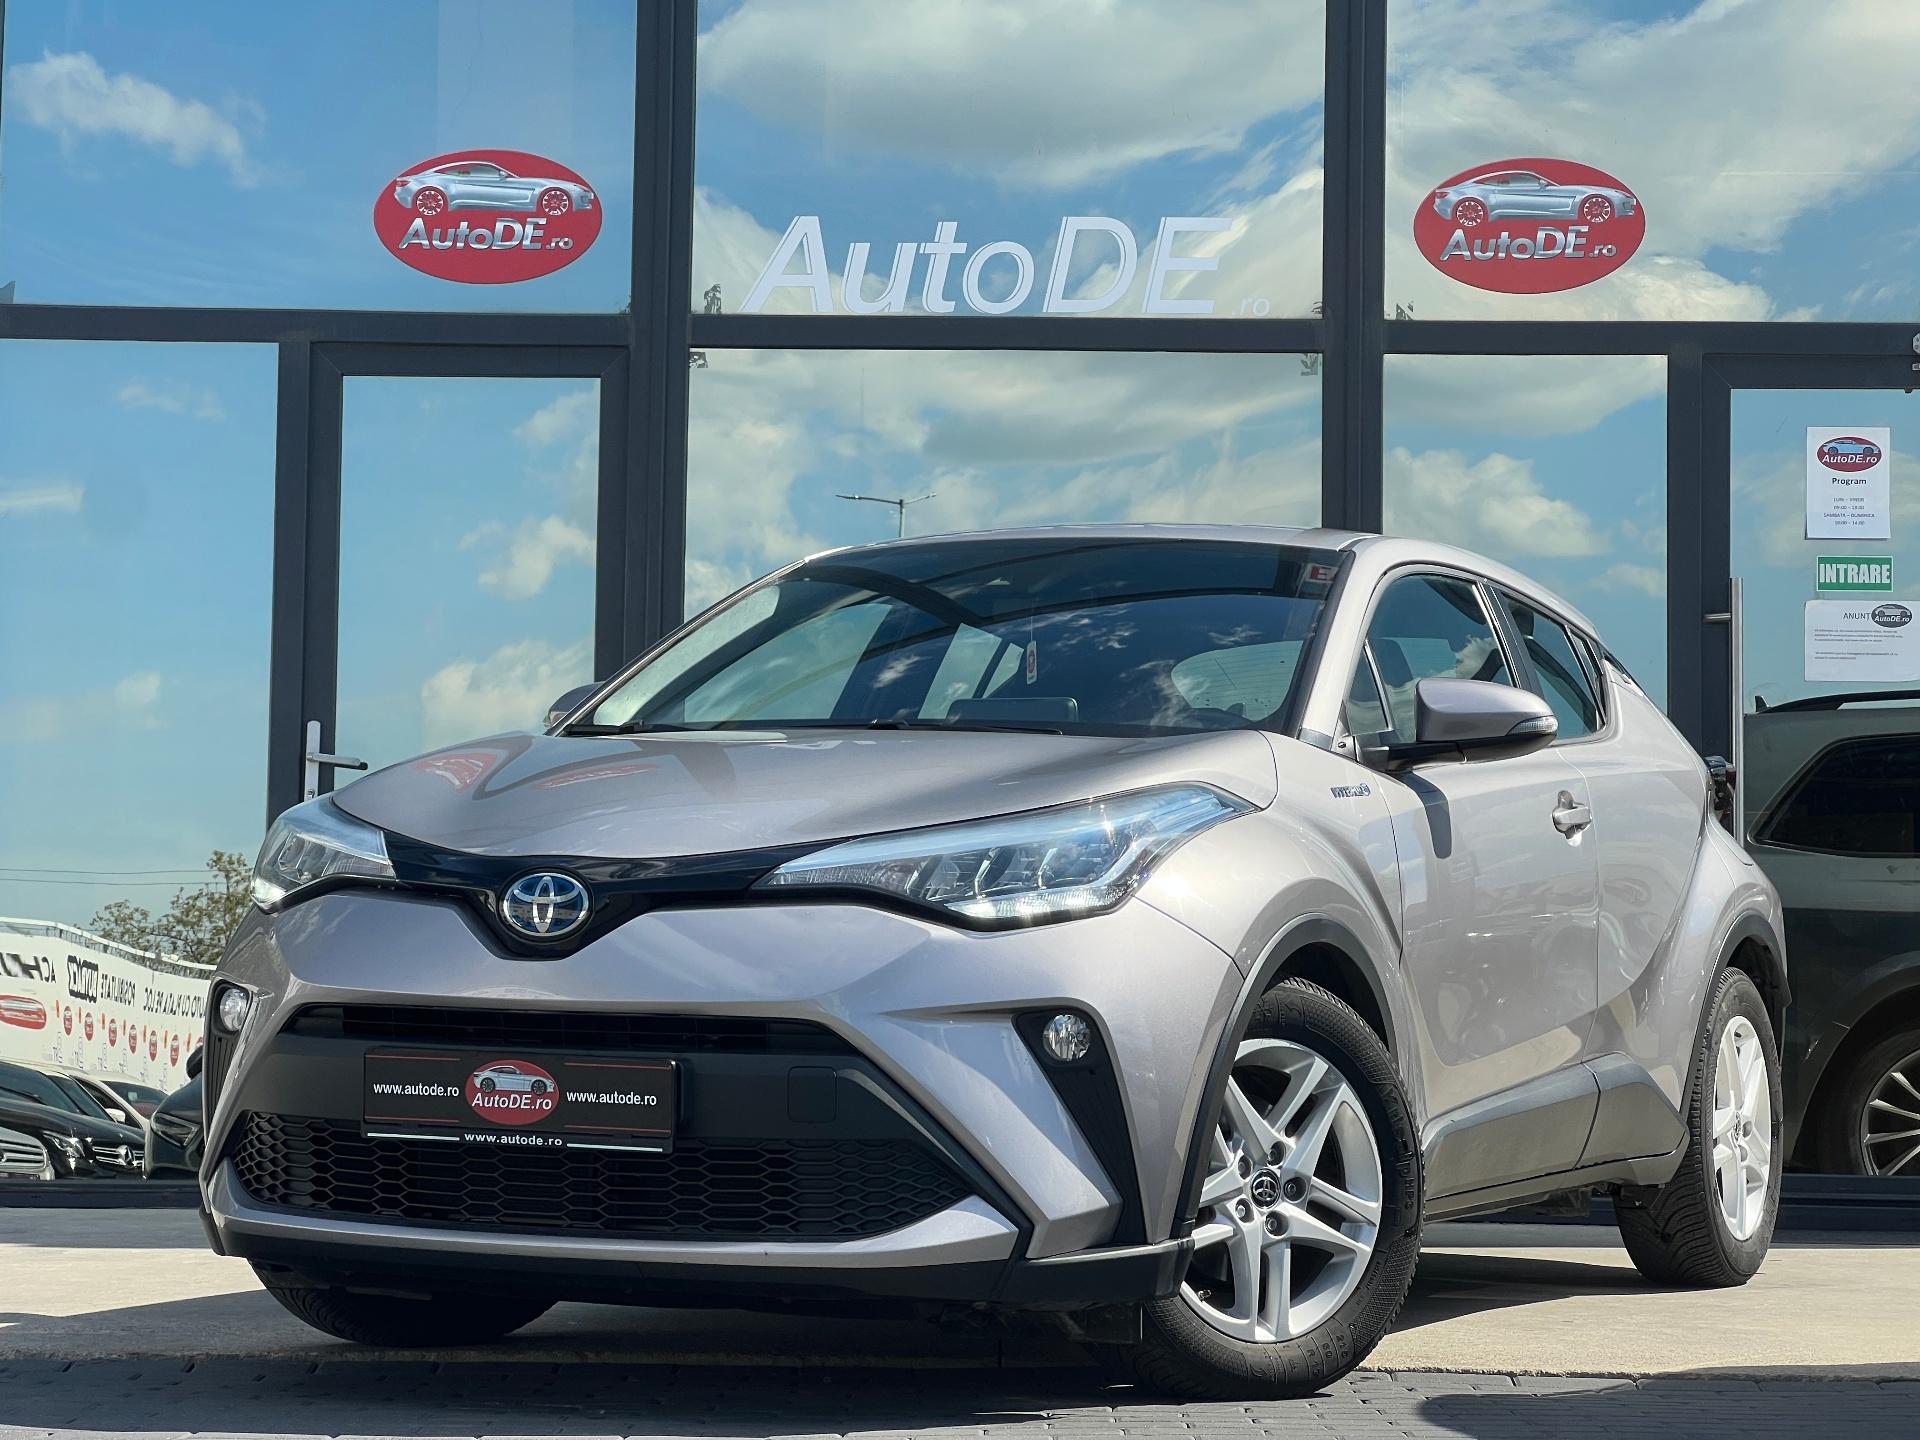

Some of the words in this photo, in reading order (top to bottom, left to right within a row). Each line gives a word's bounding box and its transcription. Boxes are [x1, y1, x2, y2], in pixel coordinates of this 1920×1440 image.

[1822, 454, 1878, 464] AutoDE.ro
[1831, 477, 1867, 486] Program
[1819, 563, 1891, 584] INTRARE
[373, 1082, 460, 1097] www.autode.ro
[471, 1092, 552, 1110] AutoDE.ro
[566, 1090, 657, 1106] www.autode.ro
[464, 1132, 563, 1146] www.autode.ro
